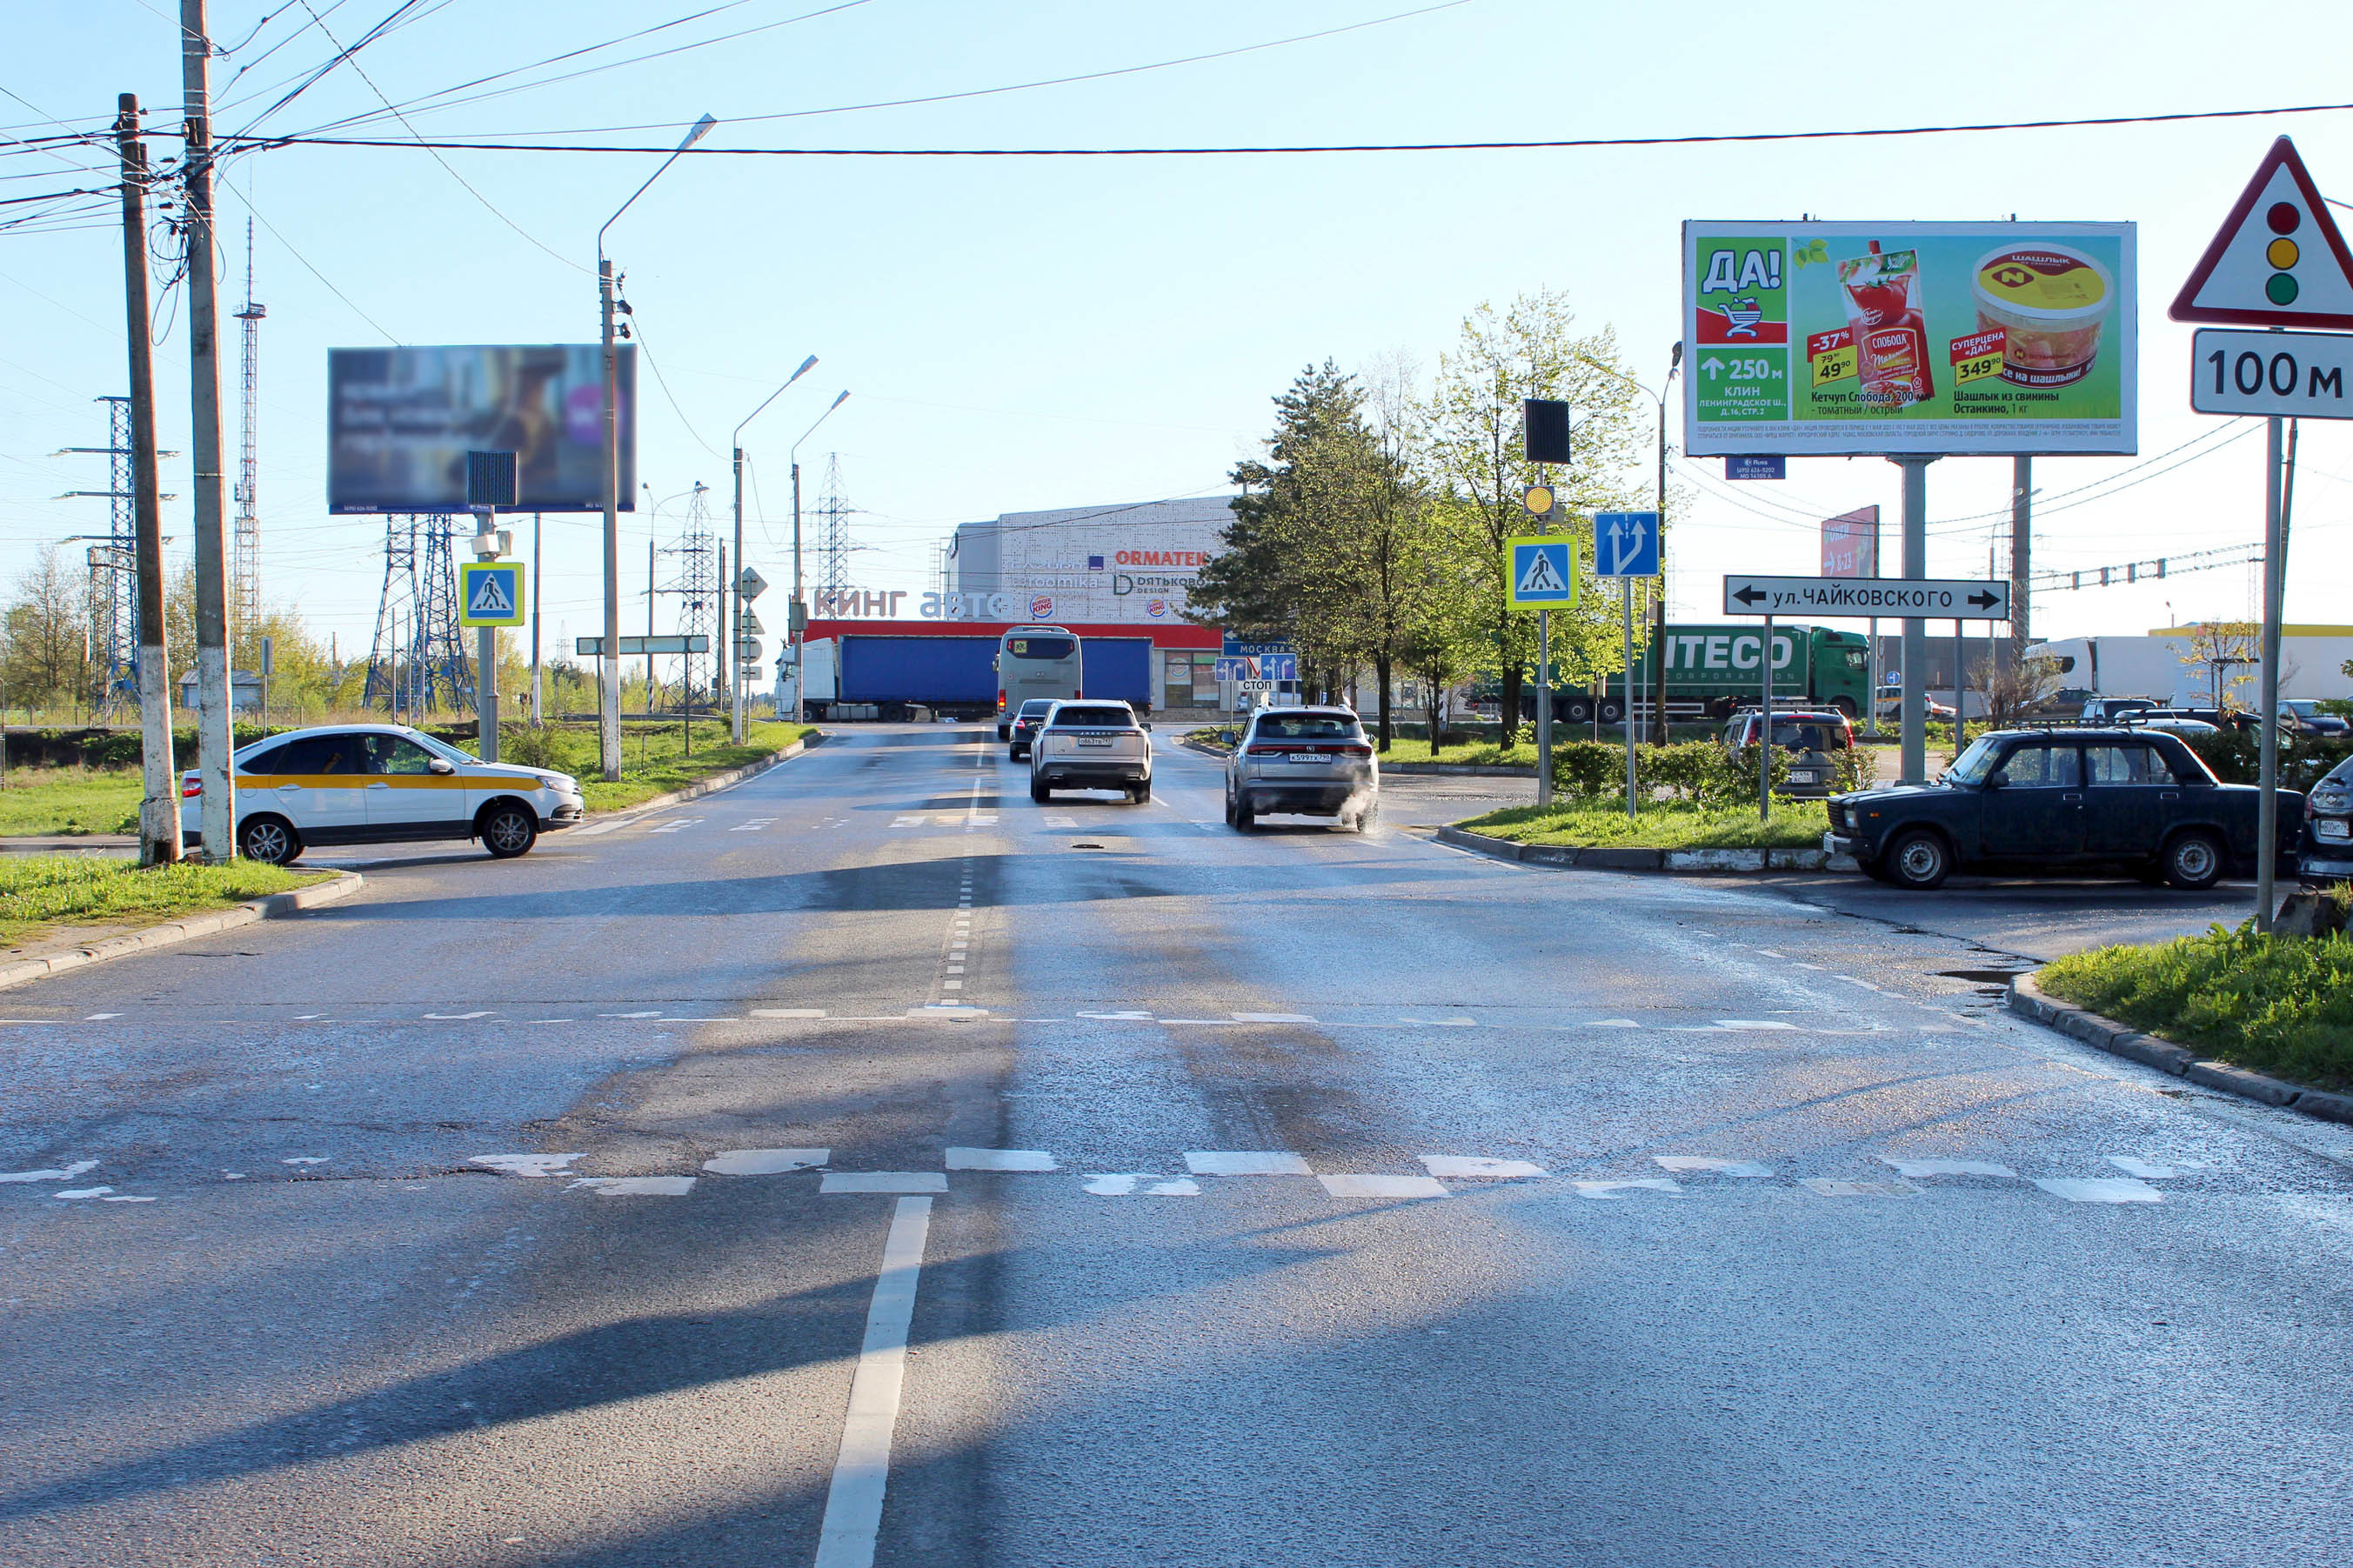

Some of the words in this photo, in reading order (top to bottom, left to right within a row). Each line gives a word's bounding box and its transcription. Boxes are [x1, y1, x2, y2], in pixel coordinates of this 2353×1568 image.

[2011, 255, 2070, 264] ШАШЛЫК
[1701, 250, 1781, 294] ДА!
[1872, 333, 1908, 348] СЛОБОДА
[1951, 331, 2005, 350] СУПЕРЦЕНА
[1729, 359, 1769, 379] 250
[2208, 350, 2297, 397] 100
[2002, 368, 2014, 377] се
[2015, 371, 2028, 382] на
[2029, 367, 2082, 384] шашлыки!
[1725, 386, 1760, 397] КЛИН
[1811, 391, 1846, 404] Кетчуп
[1848, 391, 1894, 404] Слобода,
[1896, 392, 1914, 403] 200
[1954, 391, 1999, 402] Шашлык
[1818, 406, 1862, 415] томатный
[1871, 406, 1903, 417] острый
[1954, 404, 2009, 415] Останкино,
[1115, 550, 1208, 566] ORMATEK
[1032, 597, 1052, 607] BURGER
[1033, 603, 1053, 613] KING
[1240, 645, 1286, 654] МОСКВА
[1664, 636, 1793, 670] ITECO
[1243, 681, 1272, 690] СТОП
